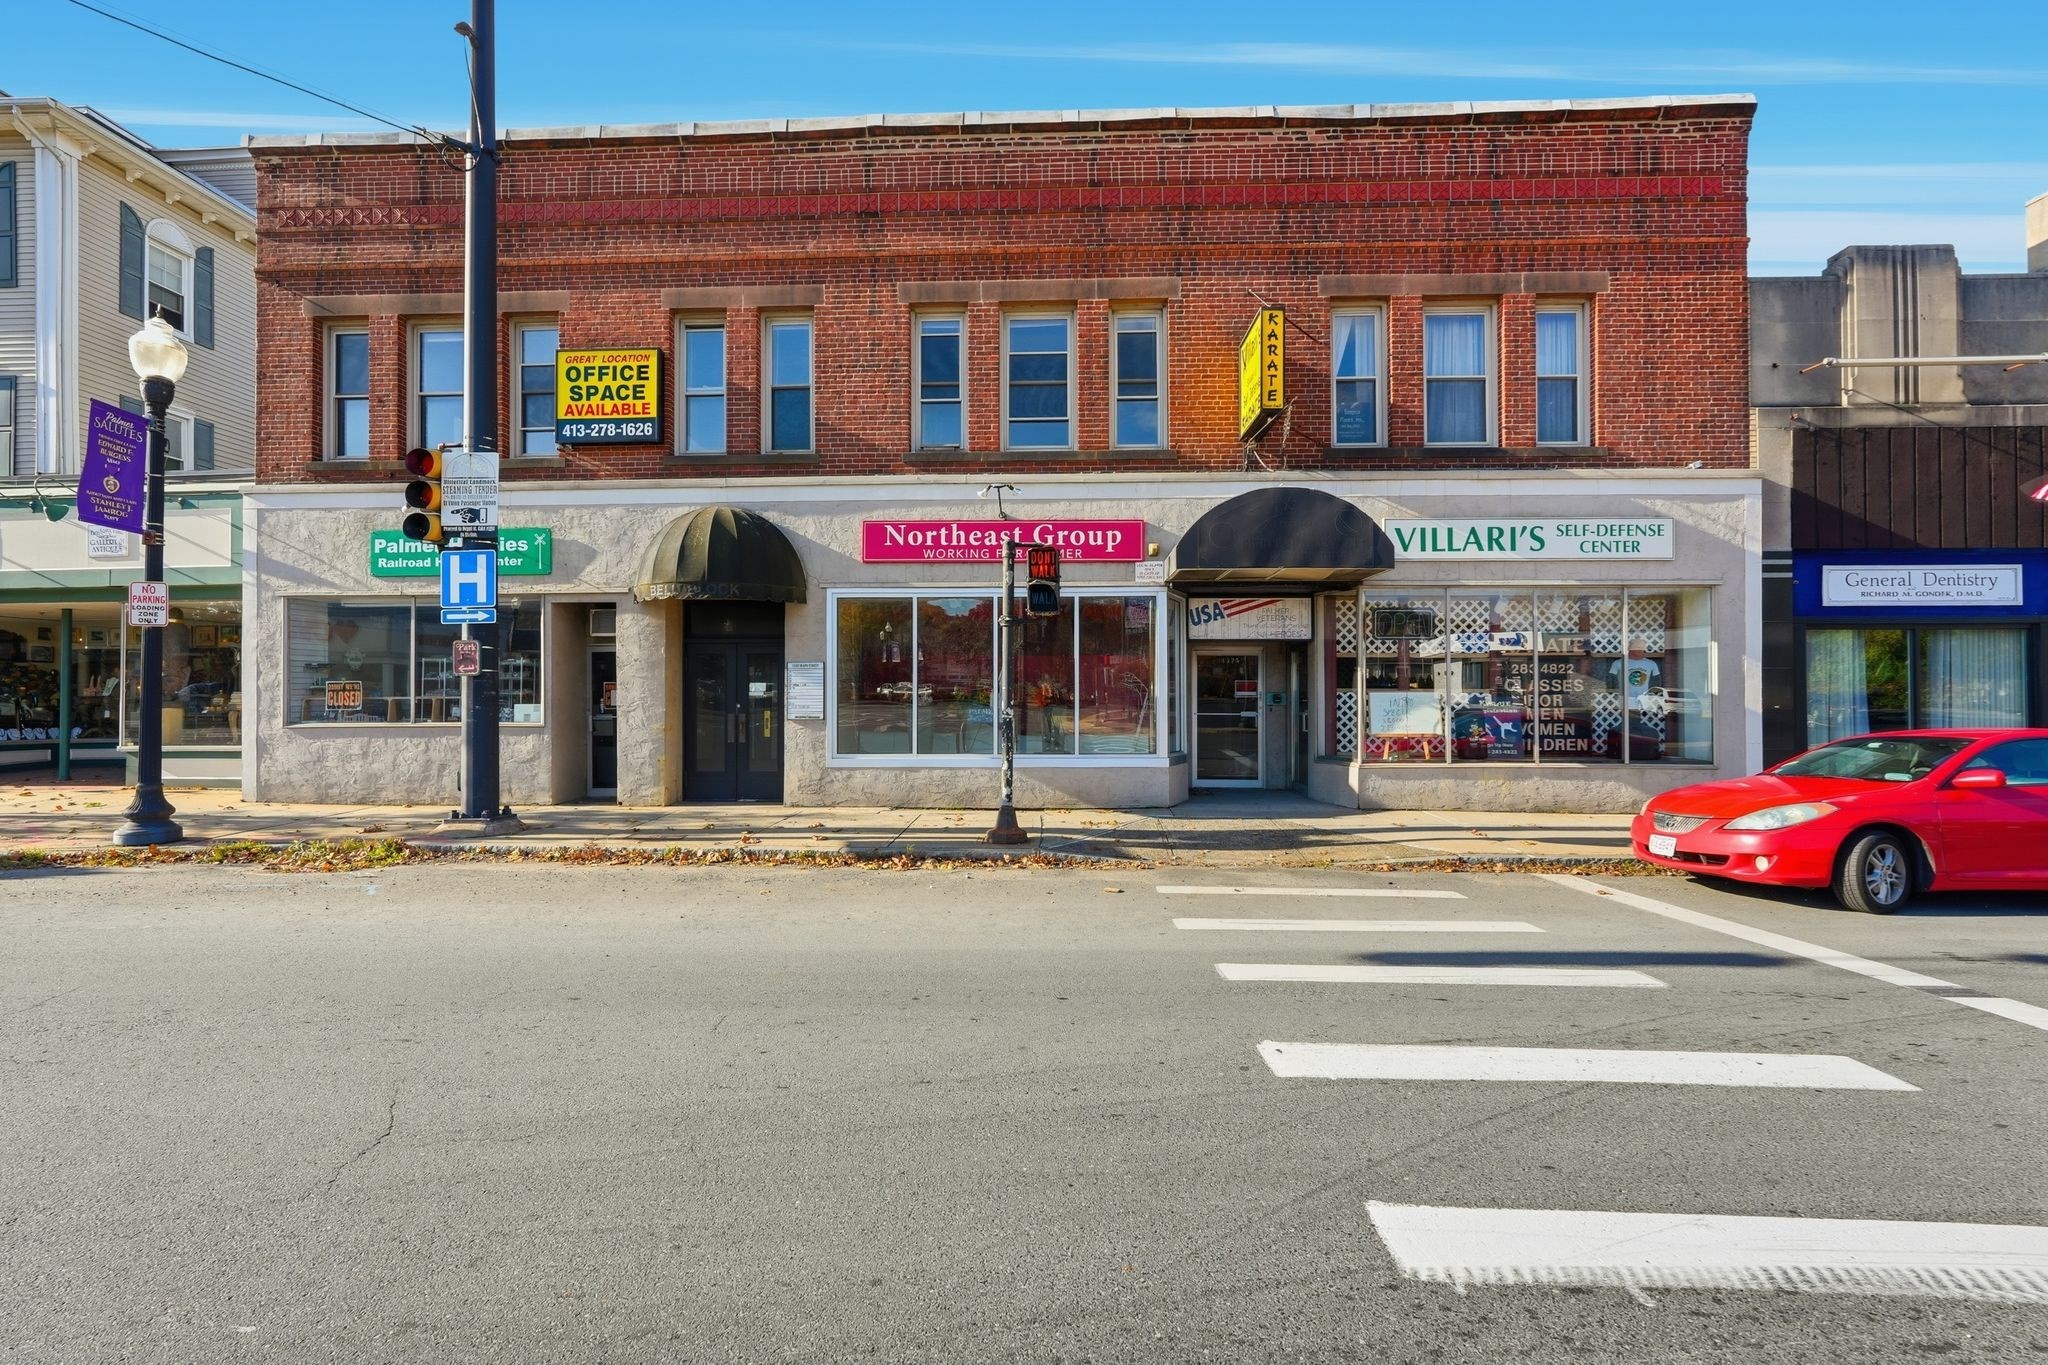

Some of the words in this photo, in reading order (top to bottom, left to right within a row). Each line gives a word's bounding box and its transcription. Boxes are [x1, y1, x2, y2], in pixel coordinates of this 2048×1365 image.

[565, 355, 597, 364] GREAT
[602, 354, 651, 363] LOCATION
[1267, 312, 1279, 401] KARATE
[565, 365, 650, 382] OFFICE
[569, 384, 646, 402] SPACE
[564, 402, 651, 417] AVAILABLE
[106, 411, 135, 429] Palmer
[93, 416, 143, 443] SALUTES
[562, 422, 653, 437] 413-278-1626
[98, 439, 127, 454] EDWARD
[443, 486, 473, 494] STEAMING
[475, 486, 497, 494] TENDER
[90, 496, 126, 509] STANLEY
[884, 524, 1021, 546] Northeast
[1033, 524, 1122, 552] Group
[1394, 526, 1546, 552] VILLARI'S
[1556, 524, 1665, 537] SELF-DEFENSE
[922, 549, 990, 559] WORKING
[996, 549, 1023, 559] FR
[1579, 540, 1641, 553] CENTER
[378, 558, 432, 568] Railroad
[498, 557, 523, 567] nter
[1030, 551, 1056, 564] DONT
[1031, 564, 1056, 577] WALK
[450, 554, 487, 604] H
[1845, 571, 1912, 587] General
[1923, 572, 1999, 591] Dentistry
[141, 585, 156, 594] NO
[132, 595, 166, 604] PARKING
[1189, 601, 1226, 626] USA
[1256, 614, 1297, 622] VETERANS
[1378, 612, 1430, 636] OPEN
[328, 691, 361, 706] CLOSED
[1528, 695, 1563, 707] FOR
[1526, 707, 1565, 720] MEN
[1523, 739, 1588, 751] IDREN
